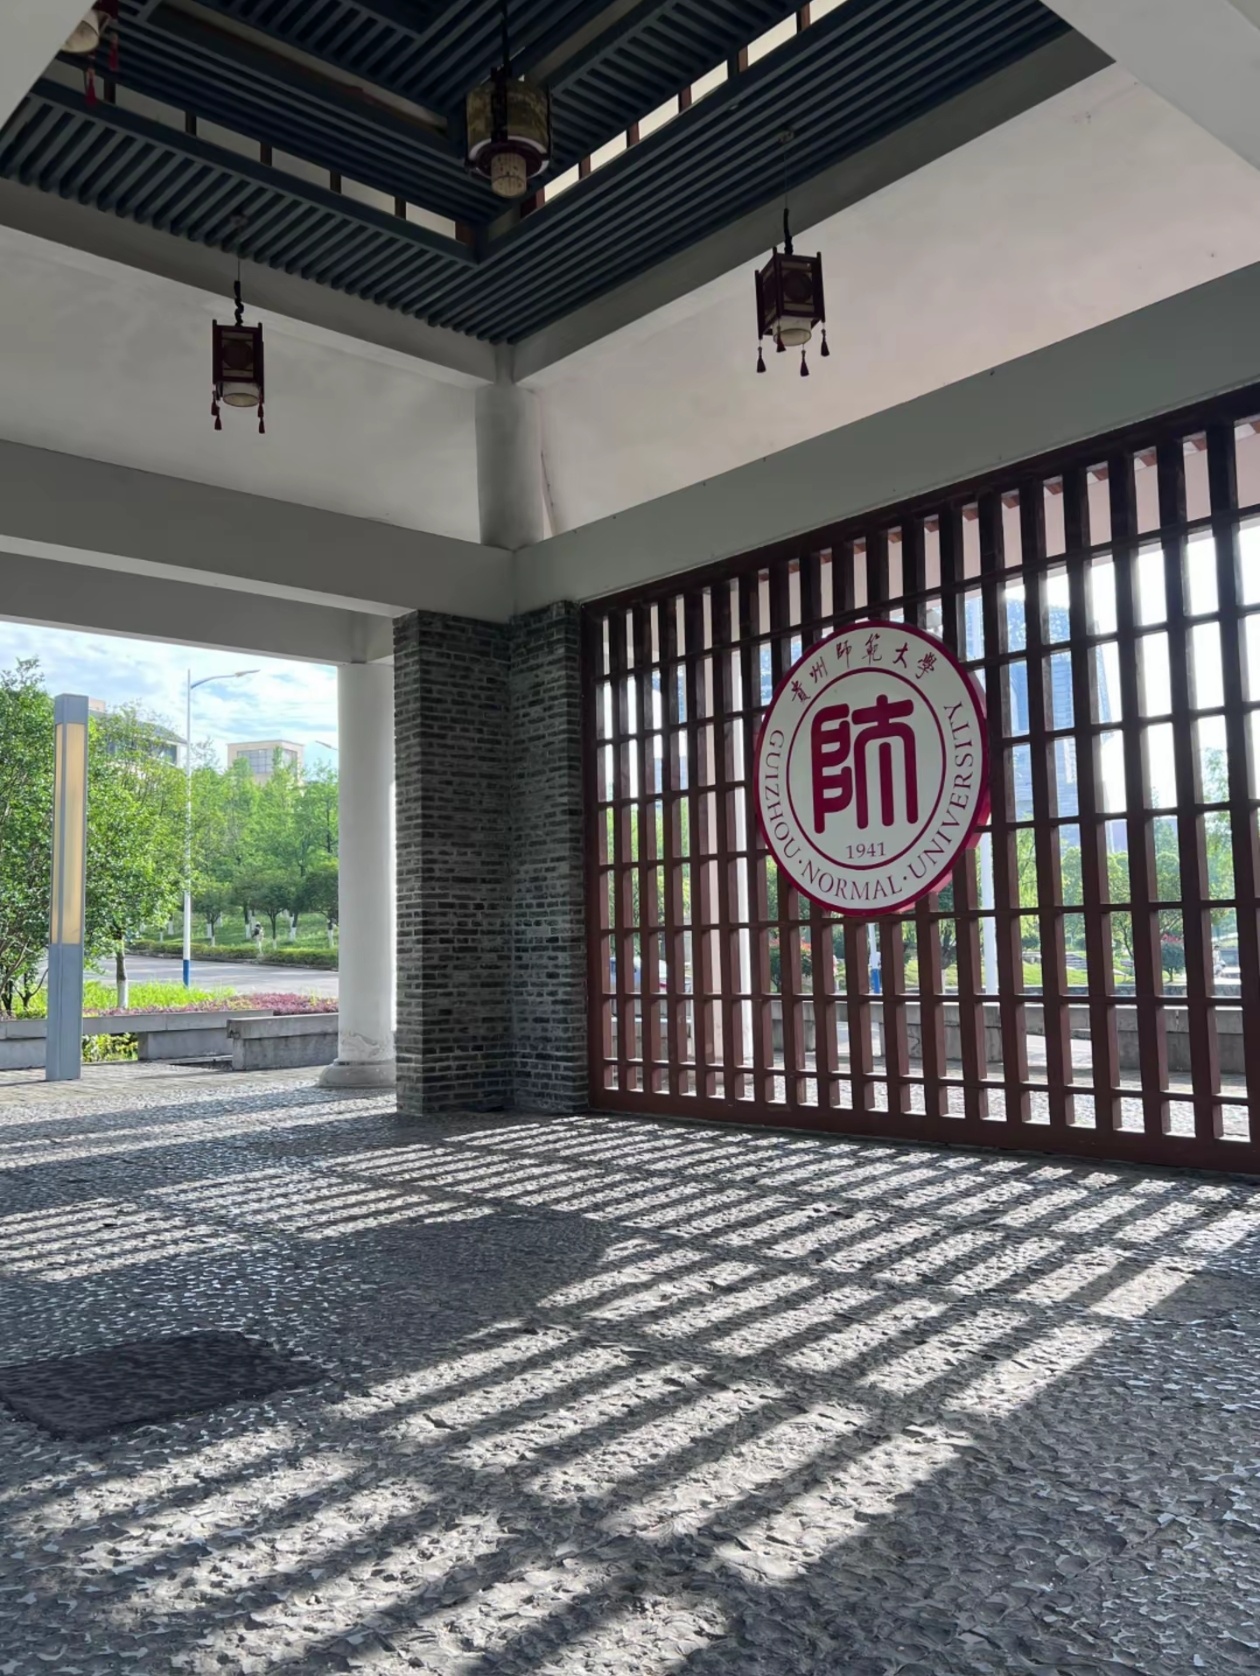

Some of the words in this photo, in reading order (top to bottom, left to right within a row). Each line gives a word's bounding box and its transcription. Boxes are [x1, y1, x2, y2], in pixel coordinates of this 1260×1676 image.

[764, 730, 801, 859] GUIZHOU
[801, 860, 902, 900] NORMAL
[908, 702, 974, 879] UNIVERSITY
[846, 842, 887, 859] 1941
